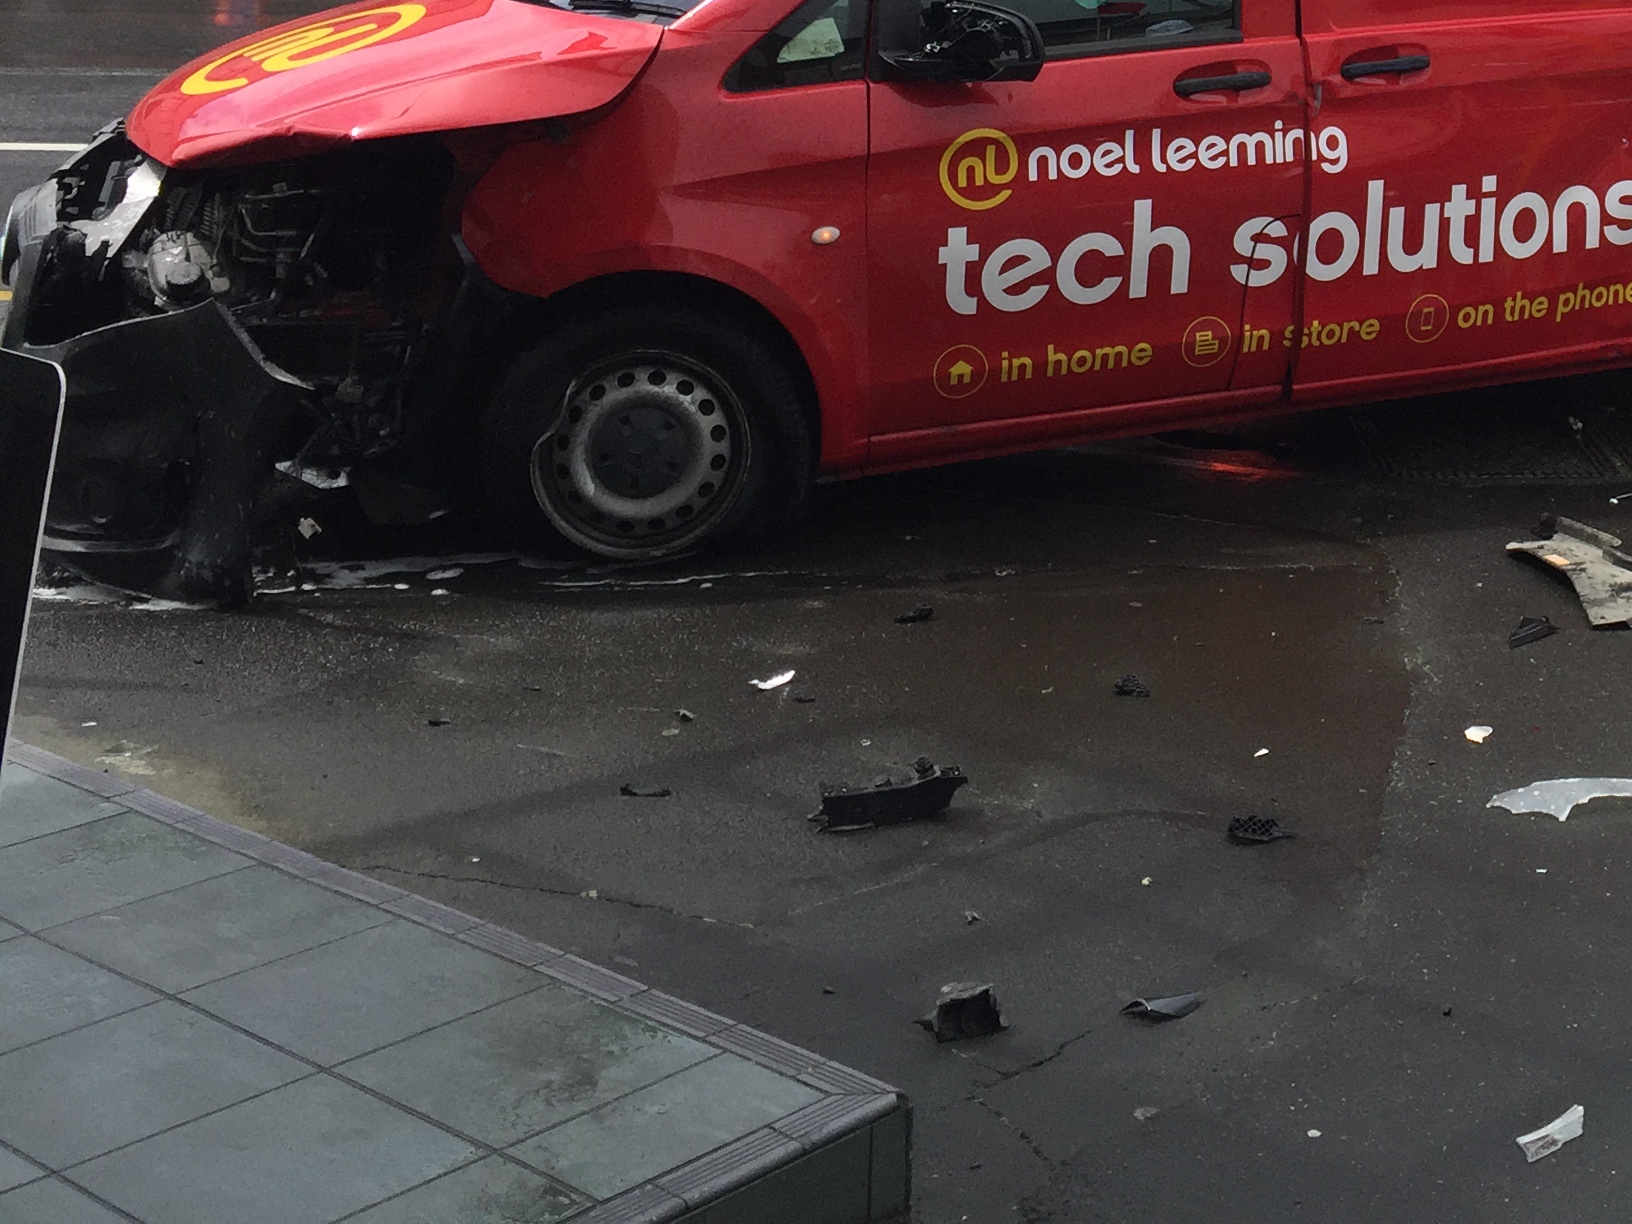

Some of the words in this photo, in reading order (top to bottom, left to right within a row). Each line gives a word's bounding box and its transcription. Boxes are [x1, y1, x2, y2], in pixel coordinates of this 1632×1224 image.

[1028, 129, 1140, 182] noel
[1151, 120, 1348, 174] leeming
[938, 198, 1191, 316] tech
[1457, 300, 1494, 330] on
[1504, 291, 1549, 322] the
[1241, 324, 1270, 354] in
[1283, 318, 1380, 350] store
[1000, 351, 1033, 383] in
[1047, 341, 1153, 378] home
